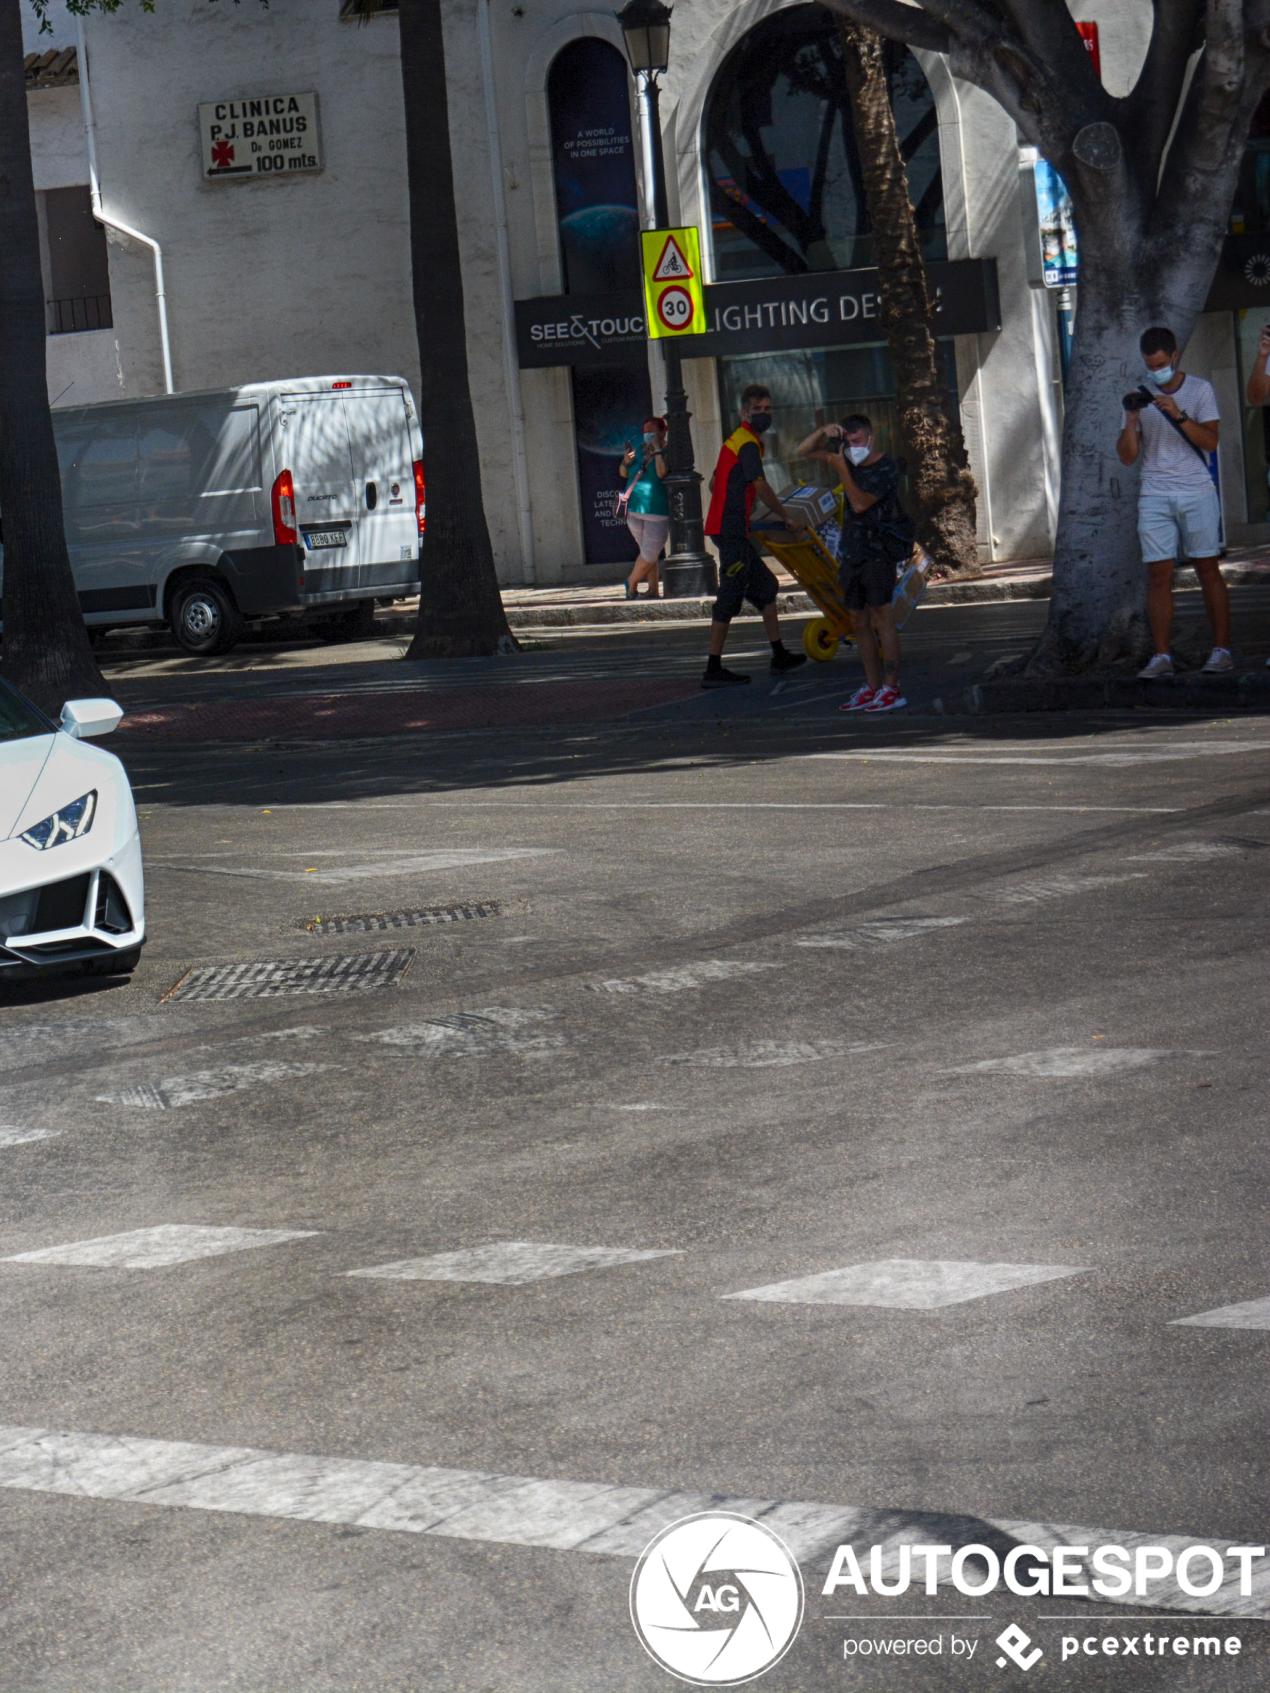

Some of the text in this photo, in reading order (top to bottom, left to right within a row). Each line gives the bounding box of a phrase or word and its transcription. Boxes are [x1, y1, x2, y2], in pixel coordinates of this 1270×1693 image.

[215, 97, 300, 121] CLINICA
[242, 116, 307, 138] BANUS
[577, 127, 615, 139] A WORLD
[268, 137, 303, 151] GOMEZ
[563, 135, 630, 150] OF POSSIBILITIES
[570, 146, 625, 158] IN ONE SPACE
[256, 153, 318, 172] 100 mts.
[664, 300, 687, 317] 30
[706, 298, 828, 333] IGHTING
[308, 494, 337, 502] DUCATO
[595, 510, 611, 518] AND
